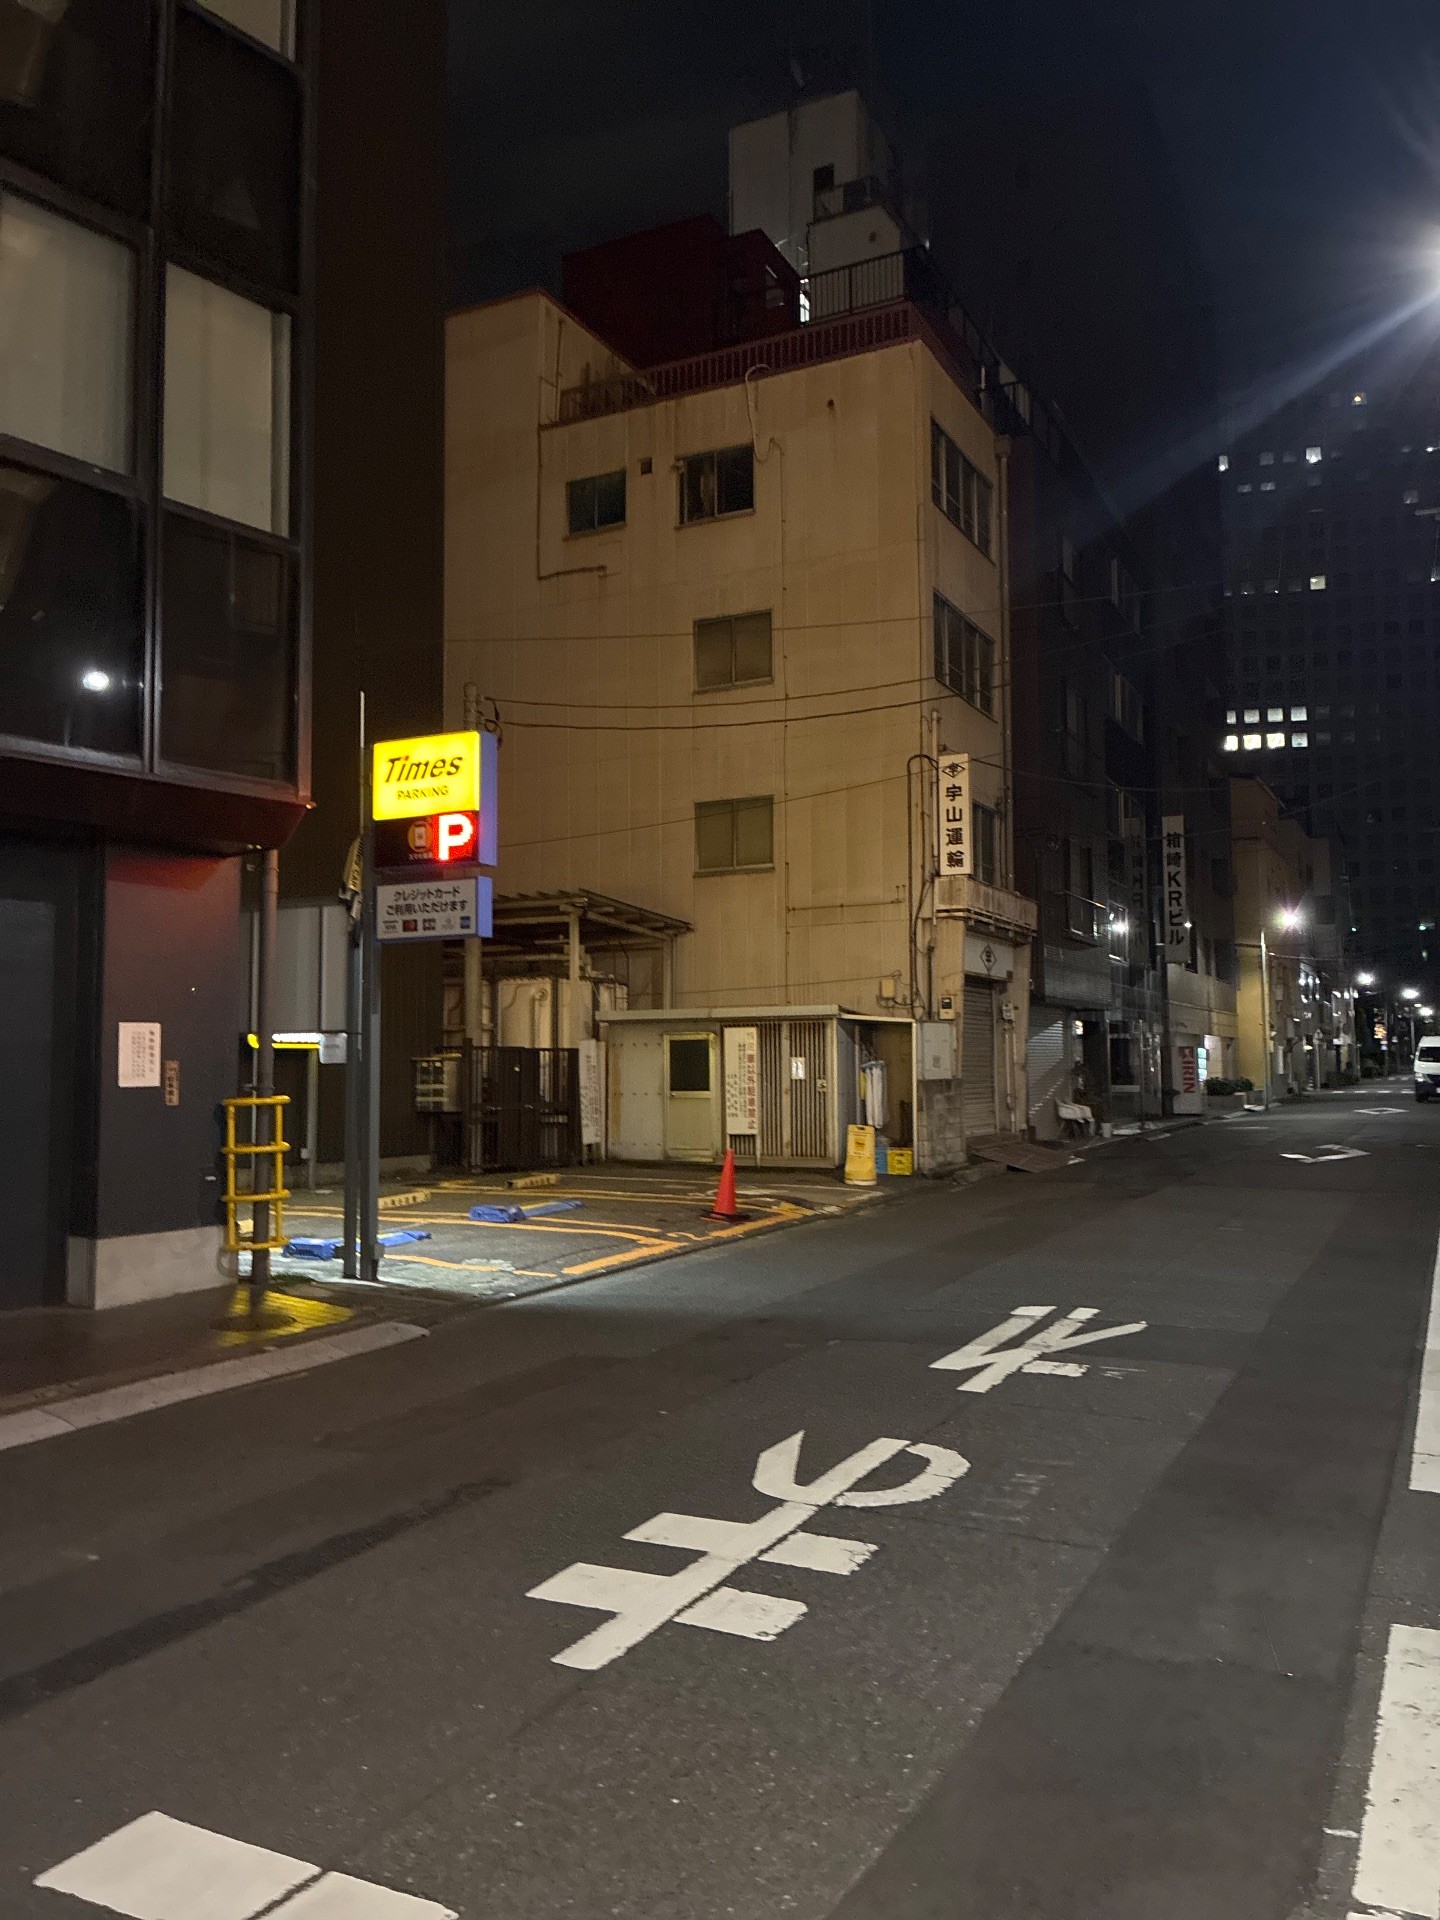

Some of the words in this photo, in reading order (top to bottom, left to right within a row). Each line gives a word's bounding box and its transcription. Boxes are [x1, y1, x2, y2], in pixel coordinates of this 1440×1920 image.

[385, 756, 463, 783] Times
[397, 786, 449, 800] PARKING
[438, 814, 473, 860] P
[945, 784, 964, 868] 宇山運輸
[393, 886, 460, 903] クレジットカード
[1166, 832, 1184, 946] 箱崎KRビル
[386, 899, 467, 917] ご利用いただけます
[1179, 1045, 1195, 1094] KIRIN
